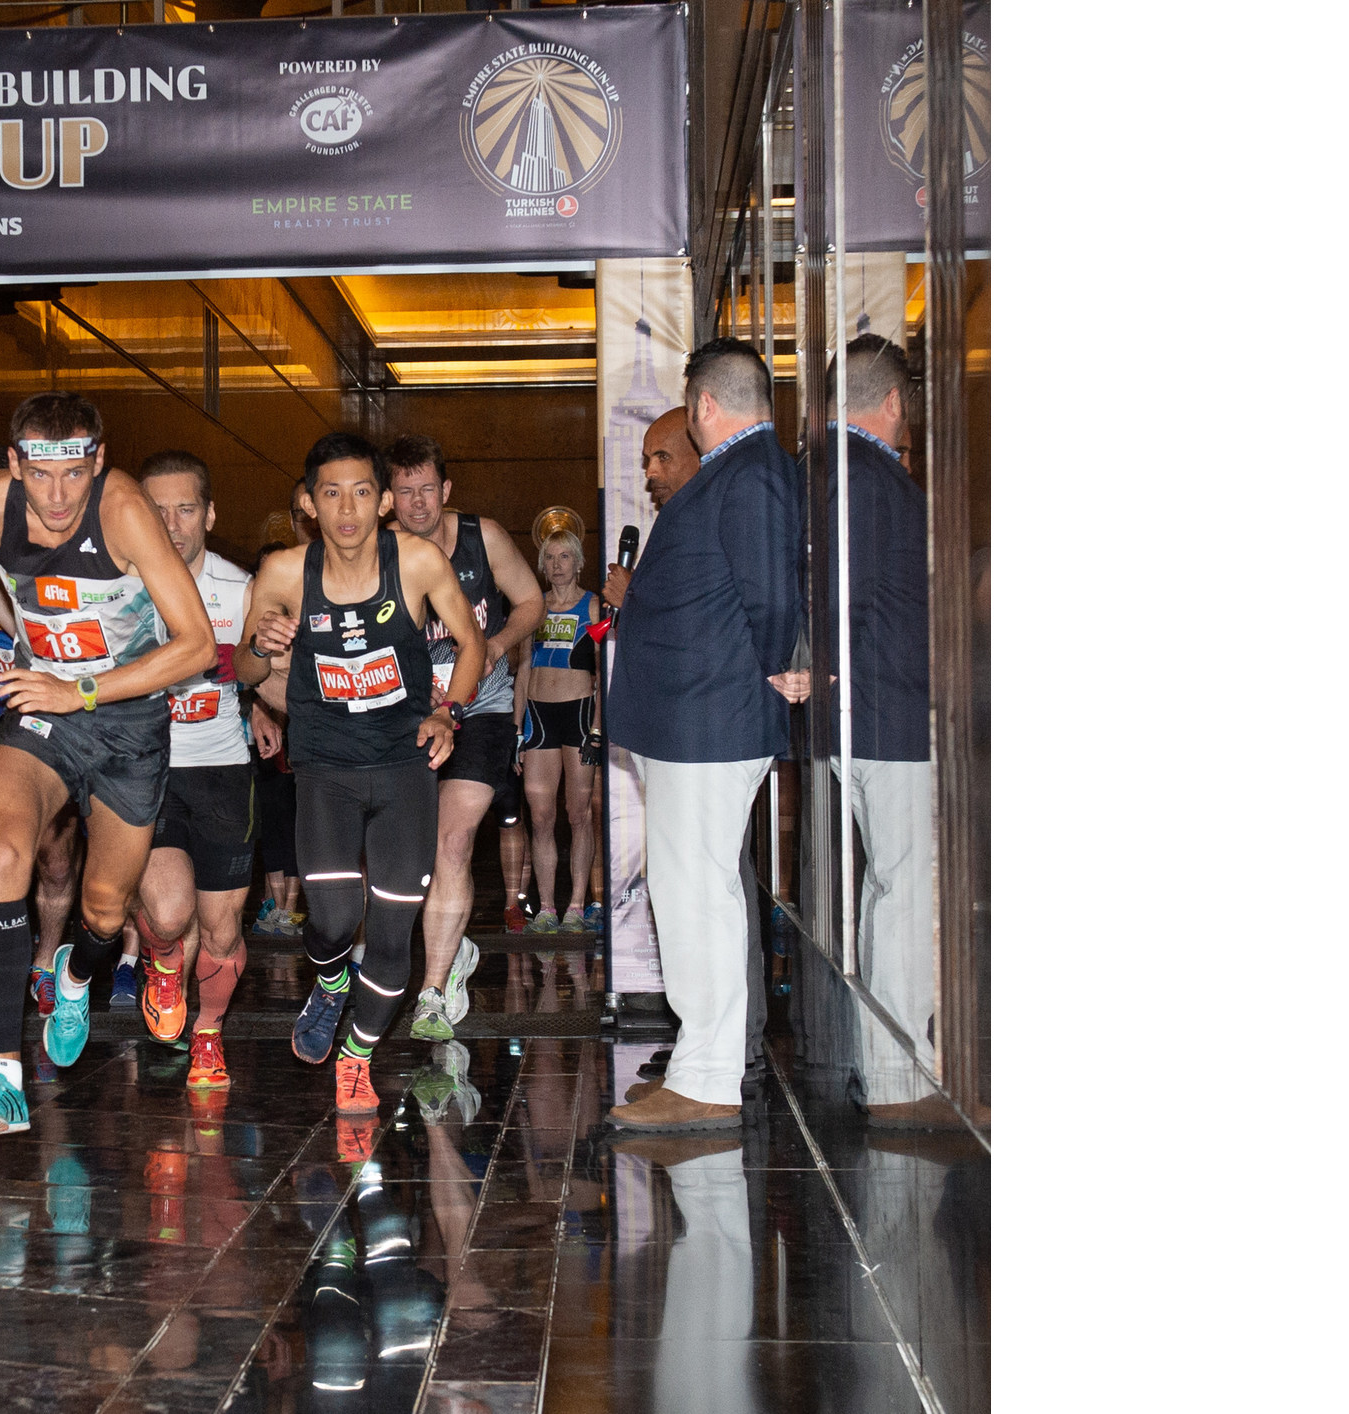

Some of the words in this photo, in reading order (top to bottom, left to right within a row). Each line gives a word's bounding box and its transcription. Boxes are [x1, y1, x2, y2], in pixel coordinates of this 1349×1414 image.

[279, 59, 357, 75] POWERED
[361, 58, 381, 72] BY
[462, 64, 495, 108] EMPIRE
[491, 44, 527, 69] STATE
[528, 43, 589, 66] BUILDING
[586, 60, 620, 103] RUN-UP
[289, 85, 337, 117] CHALLENGED
[338, 86, 374, 117] ATHLETES
[306, 109, 356, 132] CAF
[305, 140, 360, 156] FOUNDATION
[252, 196, 338, 214] EMPIRE
[347, 194, 413, 211] STATE
[505, 198, 555, 208] TURKISH
[505, 207, 555, 217] AIRLINES
[274, 218, 333, 229] REALTY
[342, 216, 392, 227] TRUST
[44, 585, 70, 602] 4Flex
[540, 624, 572, 634] AURA
[45, 632, 82, 658] 18
[322, 671, 351, 689] WAI
[352, 664, 395, 689] CHING
[356, 688, 367, 696] 17
[168, 699, 206, 714] ALF
[11, 914, 27, 926] BAY
